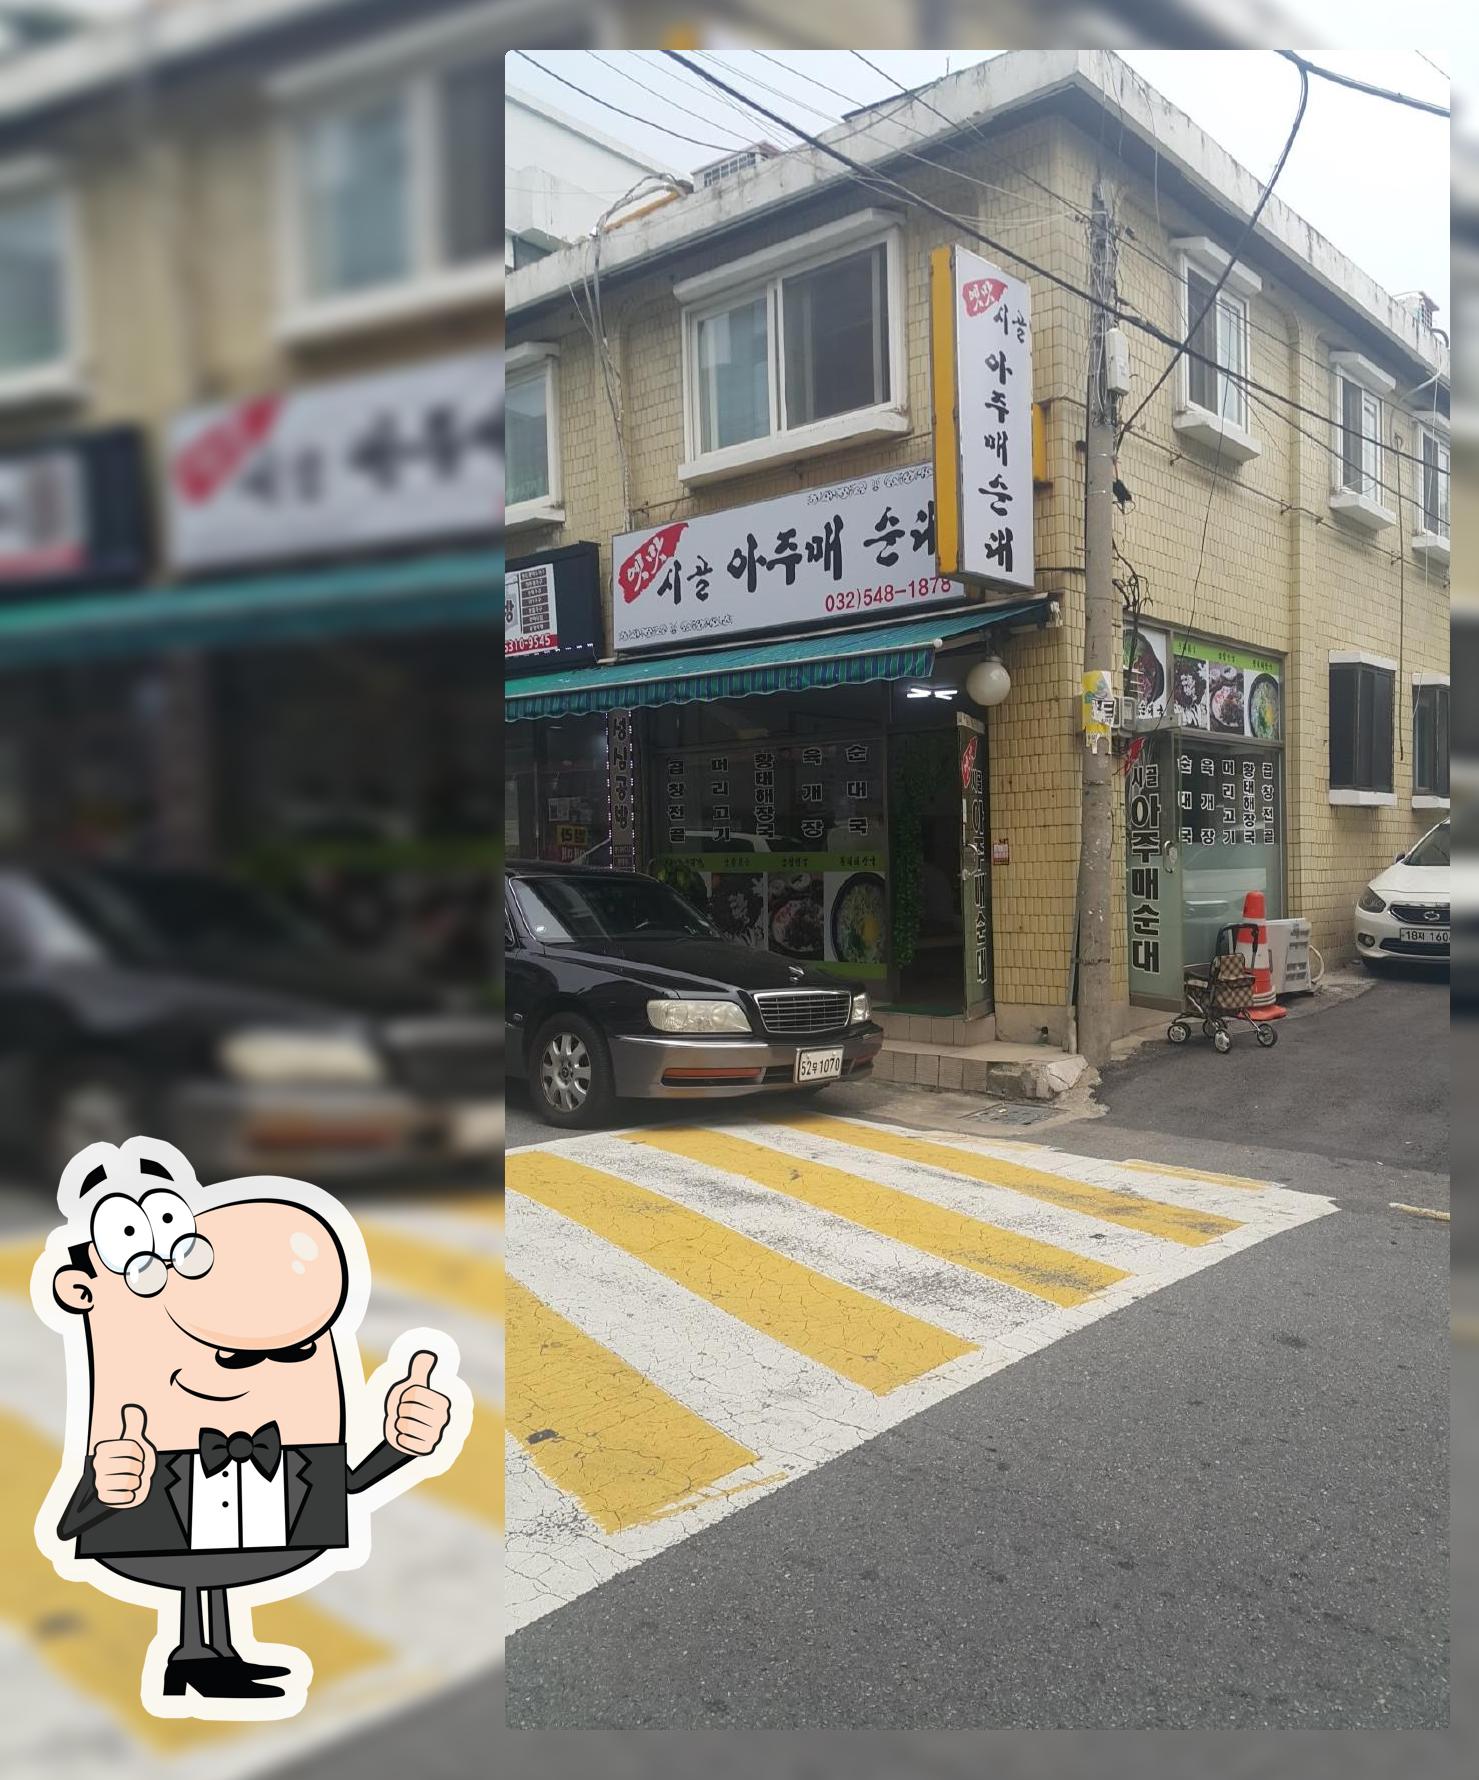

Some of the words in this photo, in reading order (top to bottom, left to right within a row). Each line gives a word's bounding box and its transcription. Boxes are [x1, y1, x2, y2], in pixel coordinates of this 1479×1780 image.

[993, 303, 1027, 344] 시골
[657, 555, 713, 605] 시골
[825, 577, 951, 612] 032)548-1878
[668, 760, 686, 843] 곱창전골
[711, 757, 731, 842] 머리고기
[753, 751, 776, 840] 황태해장국
[801, 745, 824, 839] 육개장
[845, 743, 869, 837] 순대국
[1131, 763, 1158, 789] 시골
[1177, 755, 1192, 845] 순대국
[1200, 758, 1215, 845] 육개장
[1222, 760, 1236, 845] 머리고기
[1242, 762, 1256, 845] 황태해장국
[1261, 762, 1274, 845] 곱창전골
[1130, 793, 1161, 975] 아주매순대
[1430, 932, 1450, 942] 160
